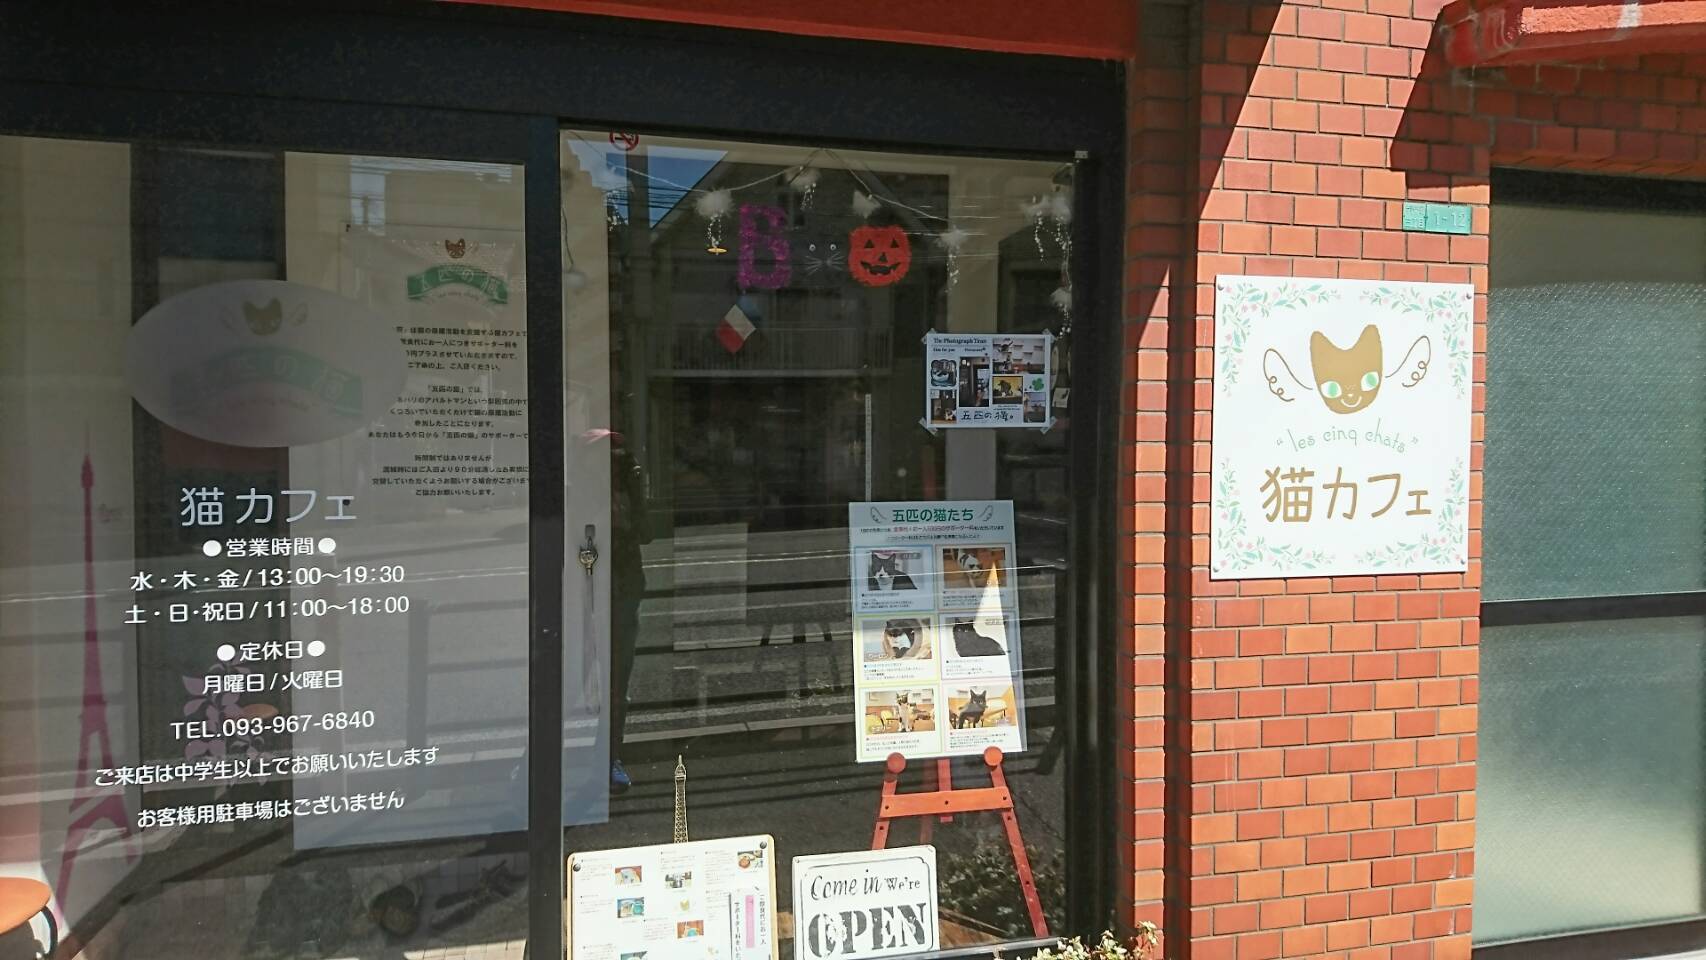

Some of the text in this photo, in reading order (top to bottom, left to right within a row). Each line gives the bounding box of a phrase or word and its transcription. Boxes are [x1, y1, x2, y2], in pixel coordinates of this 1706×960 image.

[1322, 425, 1358, 447] cinq
[179, 486, 358, 527] 猫カフェ
[1259, 466, 1433, 523] 猫カフェ
[891, 508, 975, 524] 五匹の猫たち
[225, 537, 315, 558] 営業時間
[239, 641, 304, 662] 定休日
[202, 670, 344, 695] 月曜日/火曜日
[170, 710, 376, 740] TEL.093-967-6840
[95, 745, 439, 787] ご来店は中学生以上でお願いいたします
[136, 790, 405, 829] お客様用駐車場はございません
[810, 869, 921, 901] Come in We're
[808, 902, 927, 959] OPEN
